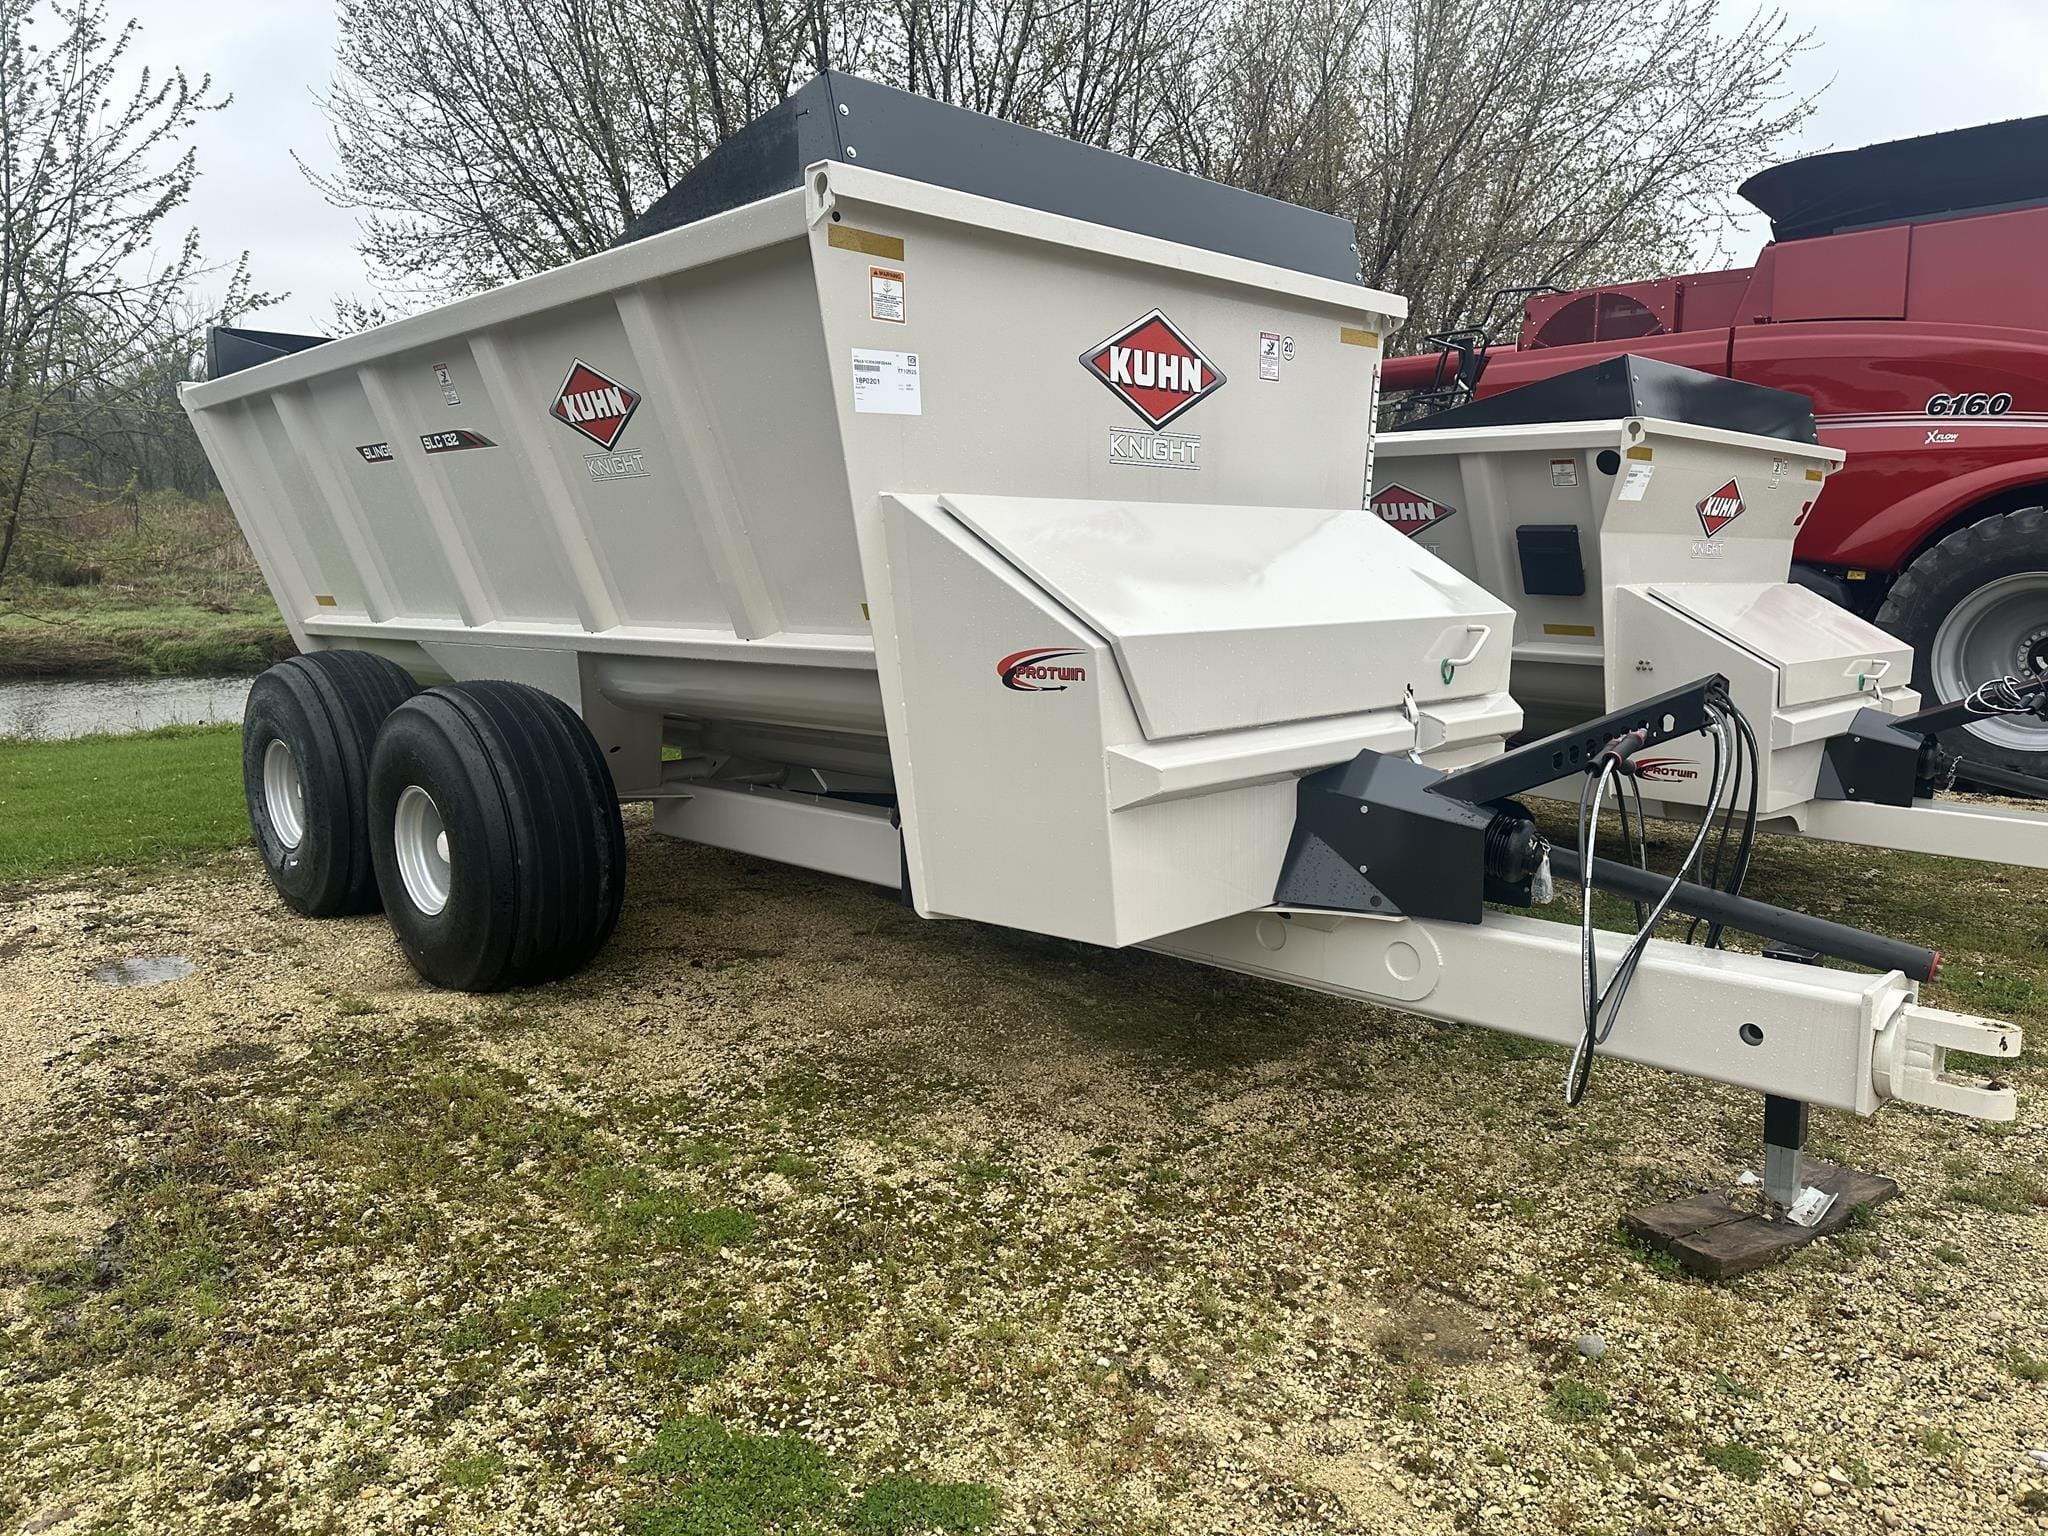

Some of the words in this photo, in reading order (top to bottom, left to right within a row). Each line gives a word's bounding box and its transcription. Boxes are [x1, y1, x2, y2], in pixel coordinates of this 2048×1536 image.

[1284, 341, 1293, 353] 20
[1109, 345, 1202, 393] KUHN
[562, 386, 627, 423] KUHN
[1925, 392, 2013, 416] 6160
[422, 435, 442, 450] SLC
[442, 432, 460, 447] 132
[1109, 433, 1201, 463] KNIGHT
[586, 454, 644, 477] KNIGHT
[1702, 496, 1741, 518] KUHN
[1691, 543, 1724, 555] KNIGHT
[1015, 665, 1086, 682] PROTWIN
[1645, 765, 1698, 779] PROTWIN
